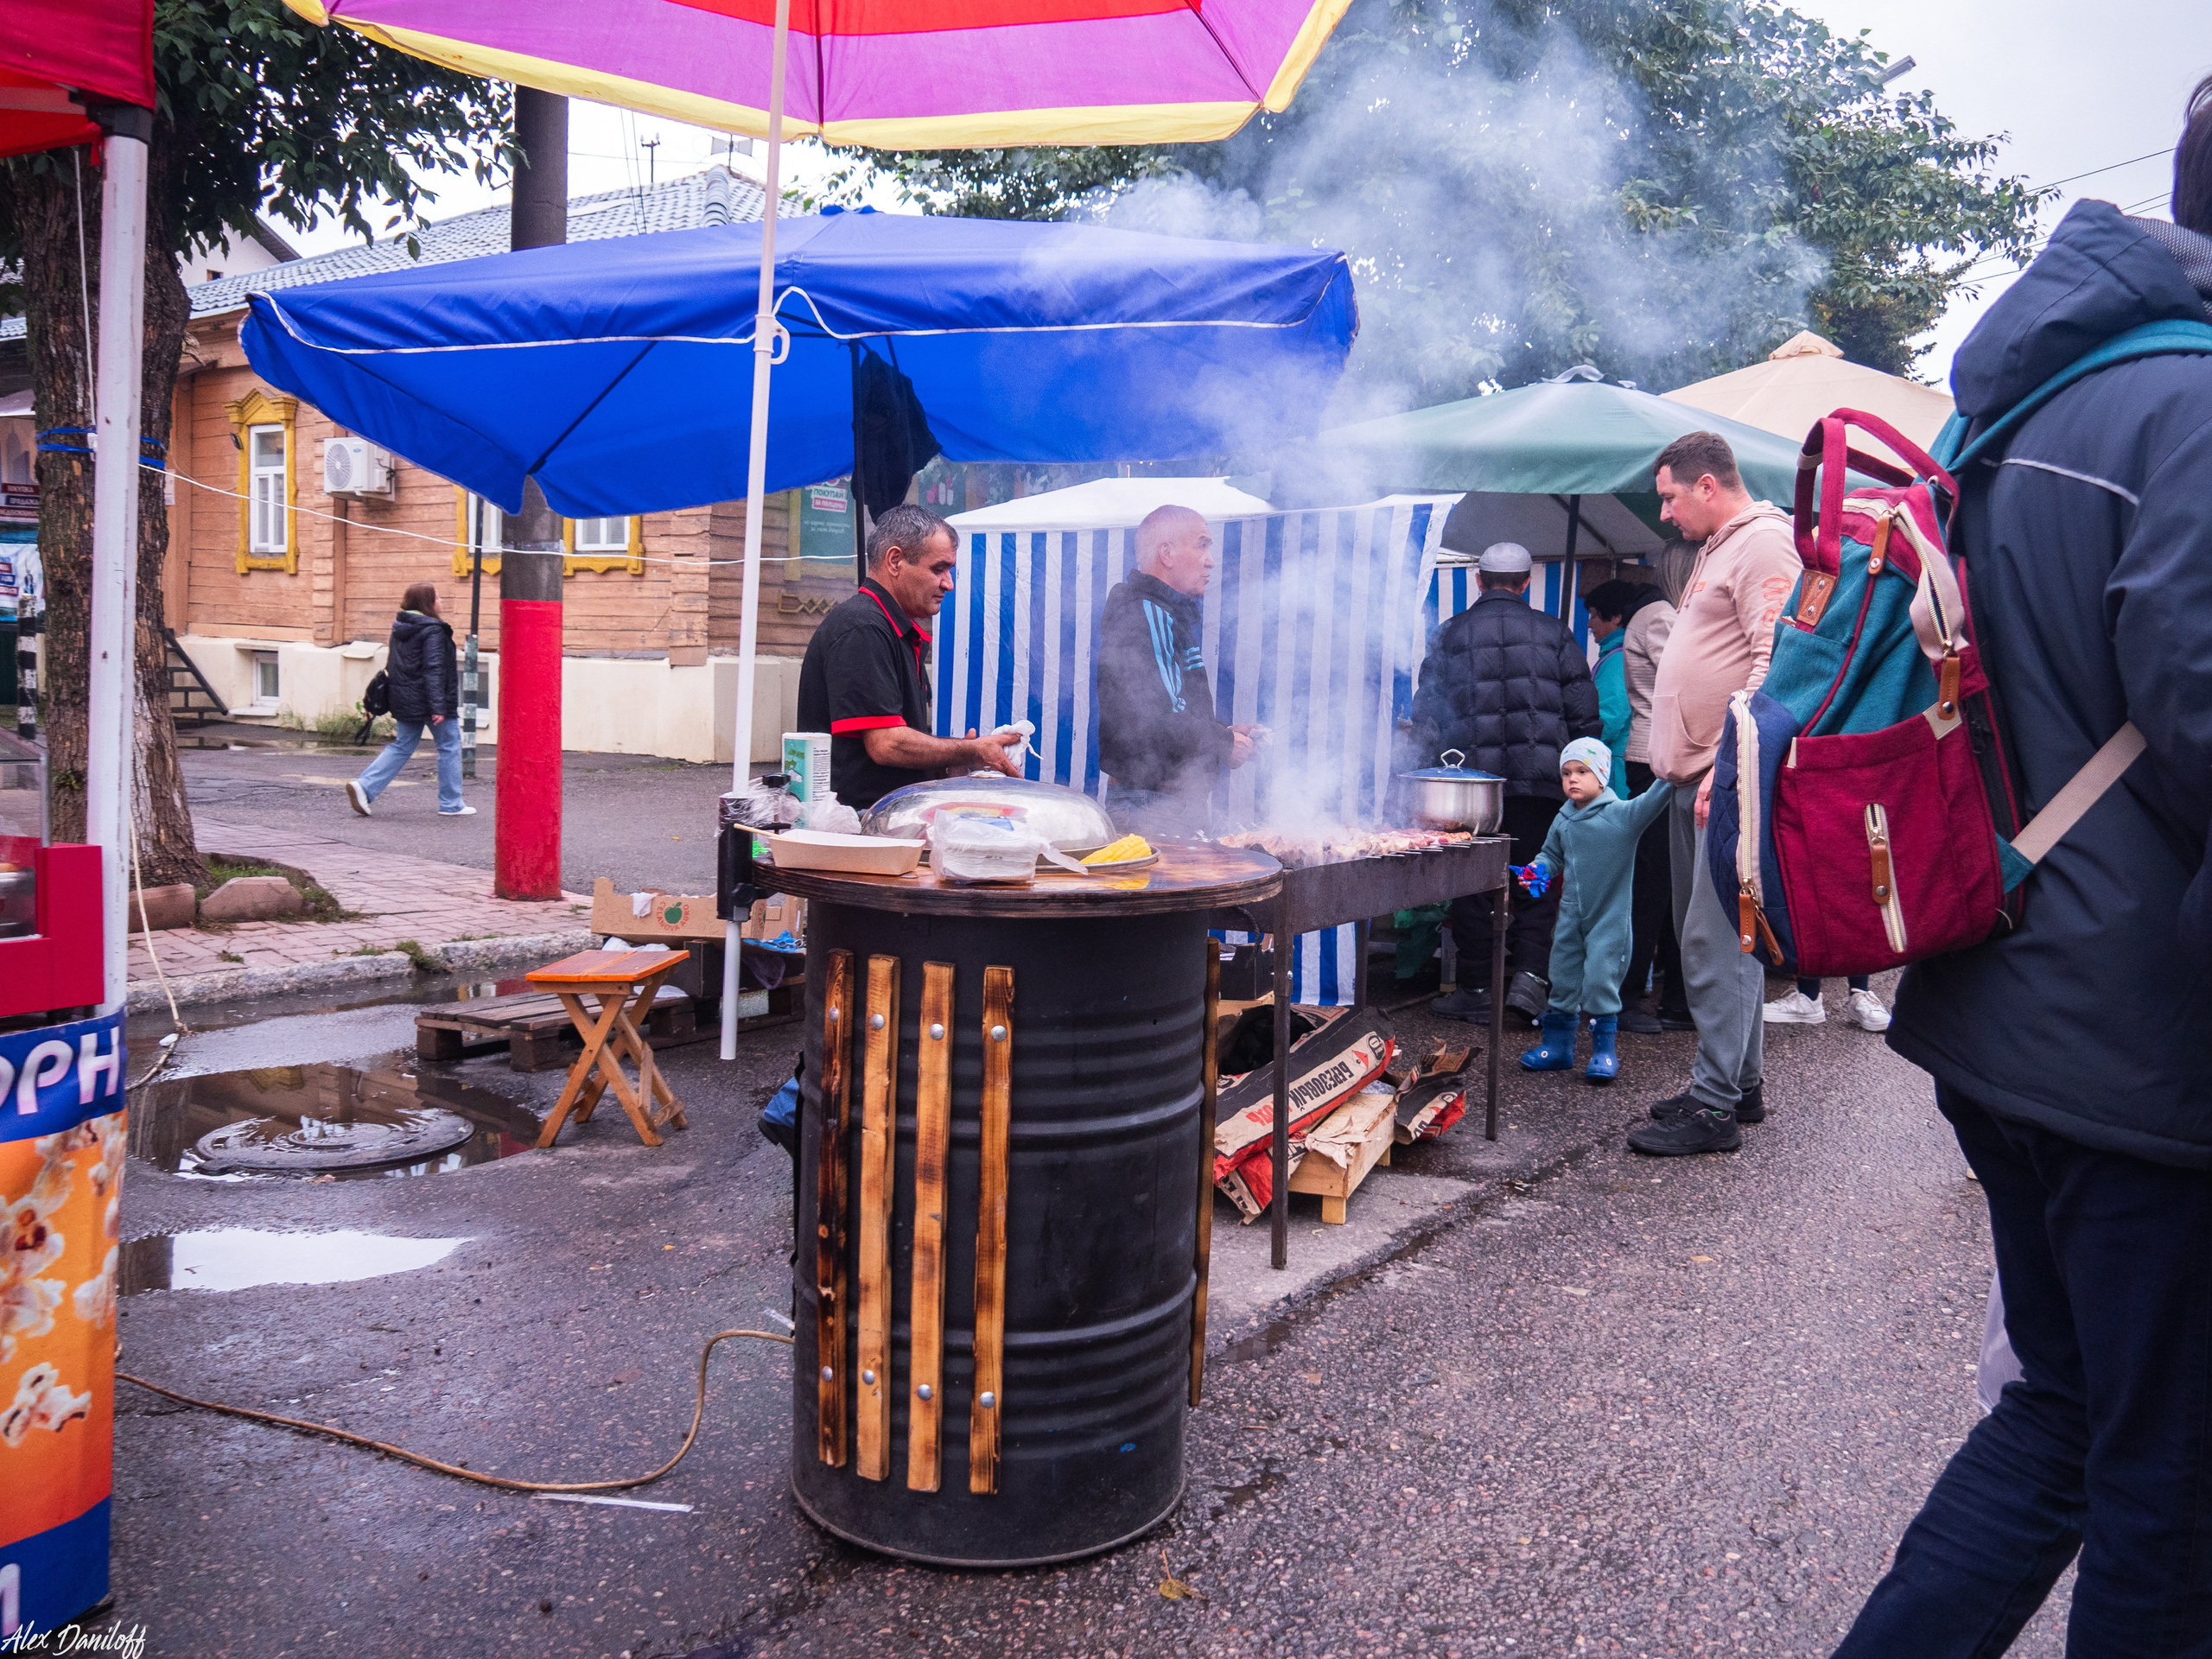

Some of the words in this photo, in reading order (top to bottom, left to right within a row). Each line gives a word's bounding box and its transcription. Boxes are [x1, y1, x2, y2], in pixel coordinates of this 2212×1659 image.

[814, 488, 844, 499] ПОКУПАЙ
[657, 901, 680, 931] CELANOVA
[680, 904, 690, 926] AGRO
[1288, 1060, 1355, 1112] БЕРЕЗОВЫЙ
